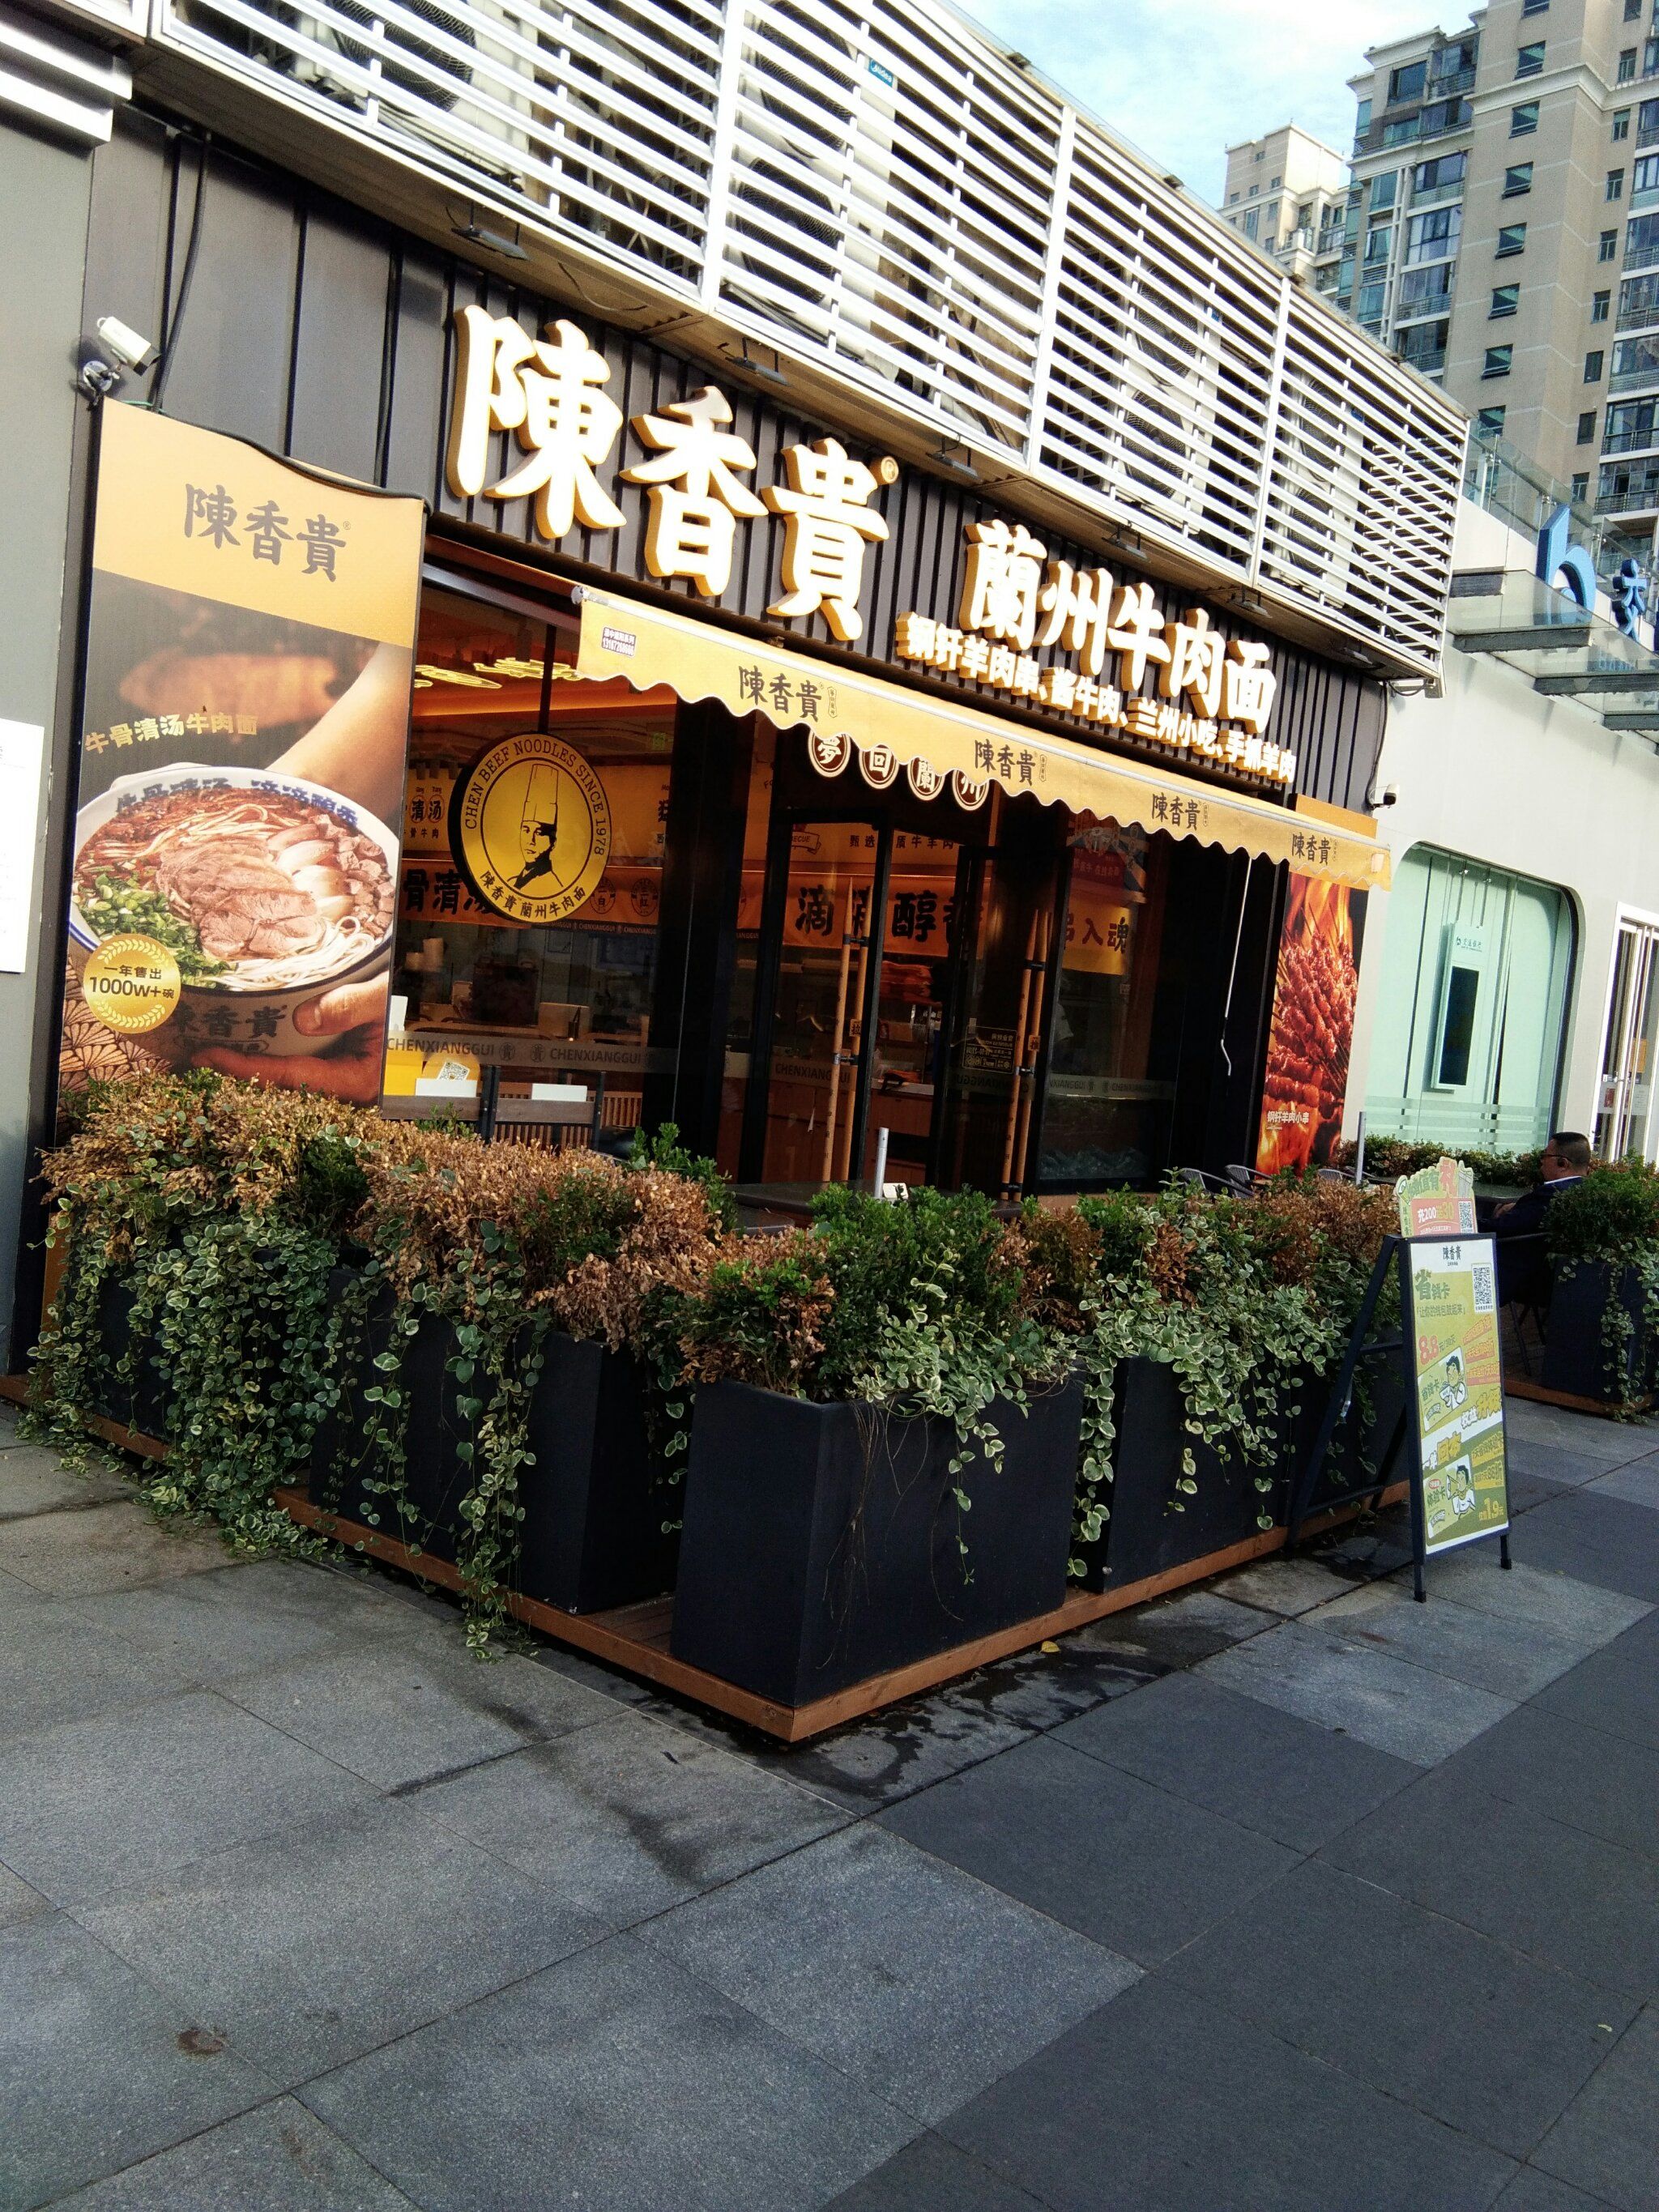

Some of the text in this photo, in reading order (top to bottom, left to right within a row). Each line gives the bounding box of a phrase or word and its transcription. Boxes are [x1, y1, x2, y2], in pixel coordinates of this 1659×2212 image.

[446, 305, 889, 641] 陳香貴
[184, 484, 346, 582] 陳香貴
[960, 519, 1277, 733] 蘭州牛肉面
[738, 665, 821, 722] 陳香貴
[85, 713, 258, 754] 牛骨清汤牛肉面
[975, 739, 1036, 786] 陳香貴
[466, 739, 607, 856] CHEN BEEF NOODLES SINCE 1978
[1152, 792, 1201, 831] 陳香貴
[1291, 832, 1331, 866] 陳香貴
[480, 871, 586, 920] 陳香貴 蘭州牛肉面
[104, 965, 162, 980] 一年售出
[775, 1063, 850, 1082] CHENXIANGUI
[1443, 1245, 1461, 1260] 陳香貴
[1415, 1269, 1450, 1300] 省钱卡
